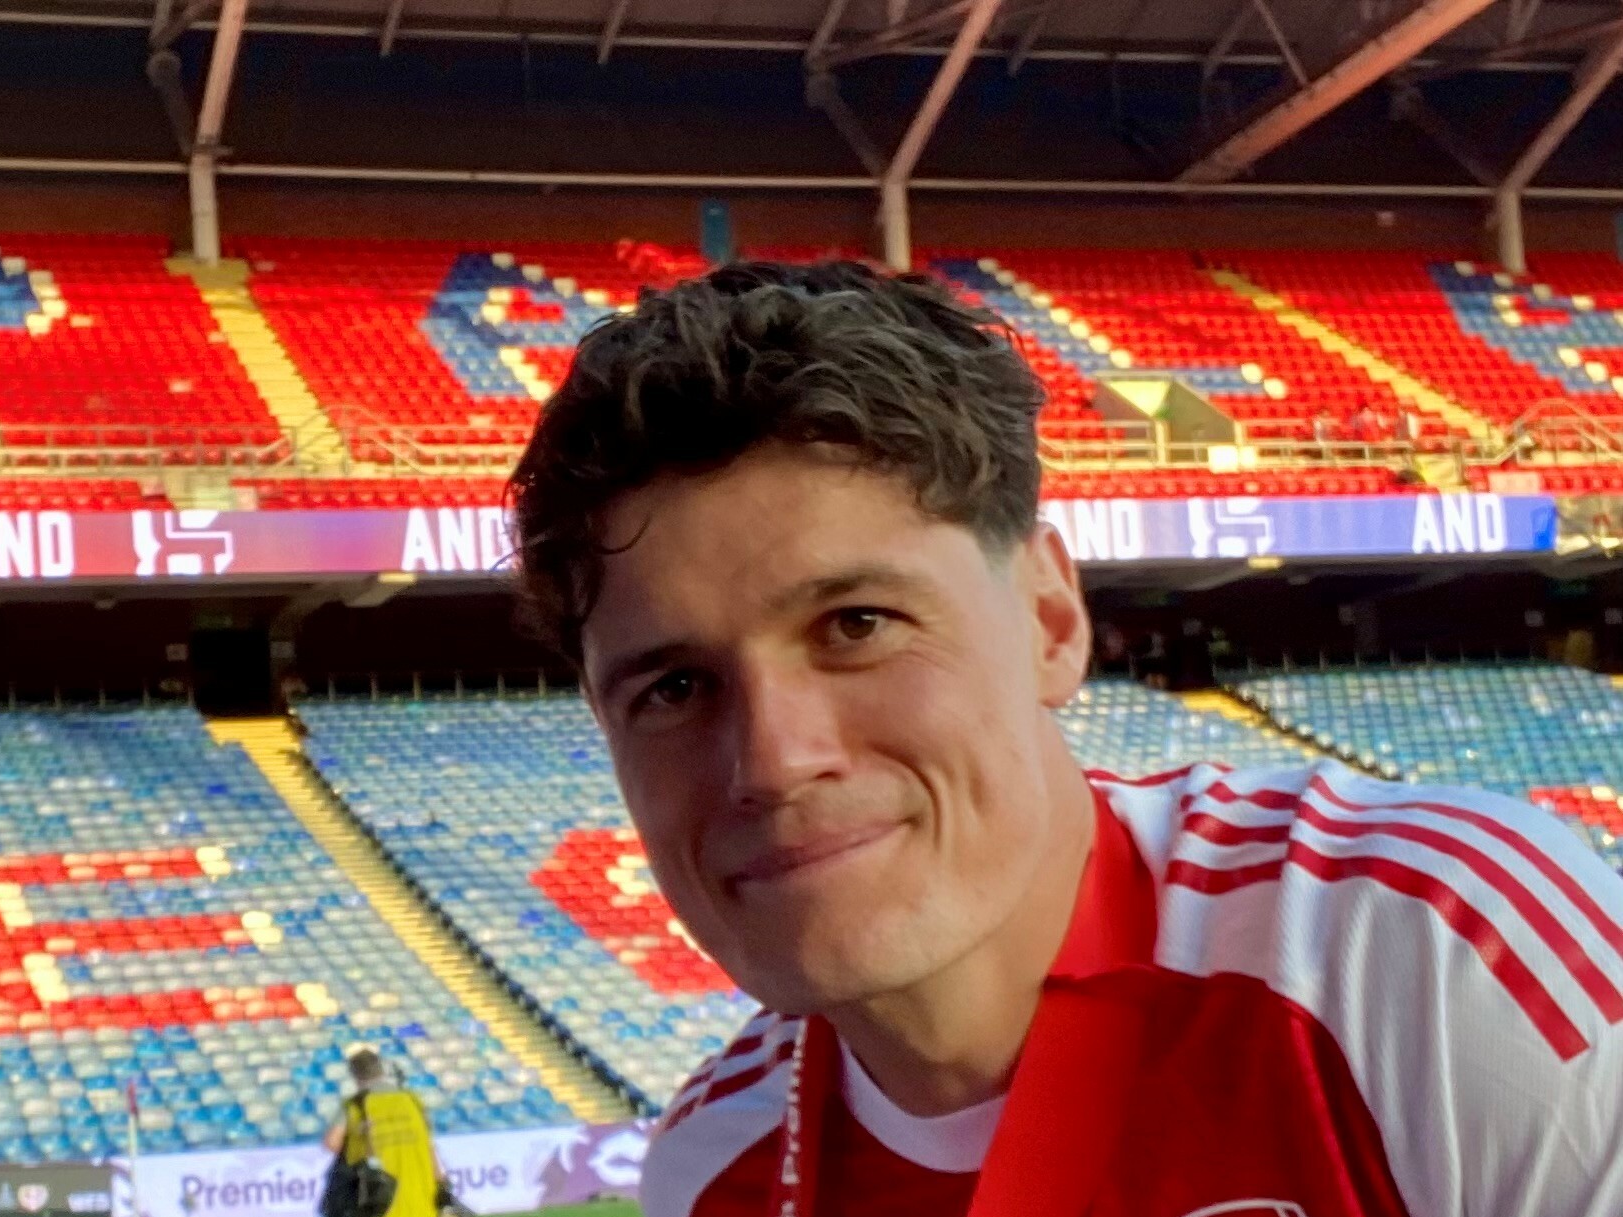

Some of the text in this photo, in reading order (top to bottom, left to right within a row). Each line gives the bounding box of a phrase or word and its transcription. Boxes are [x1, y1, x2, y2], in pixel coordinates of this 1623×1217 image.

[401, 506, 517, 571] AND
[1412, 493, 1506, 553] AND
[181, 1168, 319, 1211] Premier
